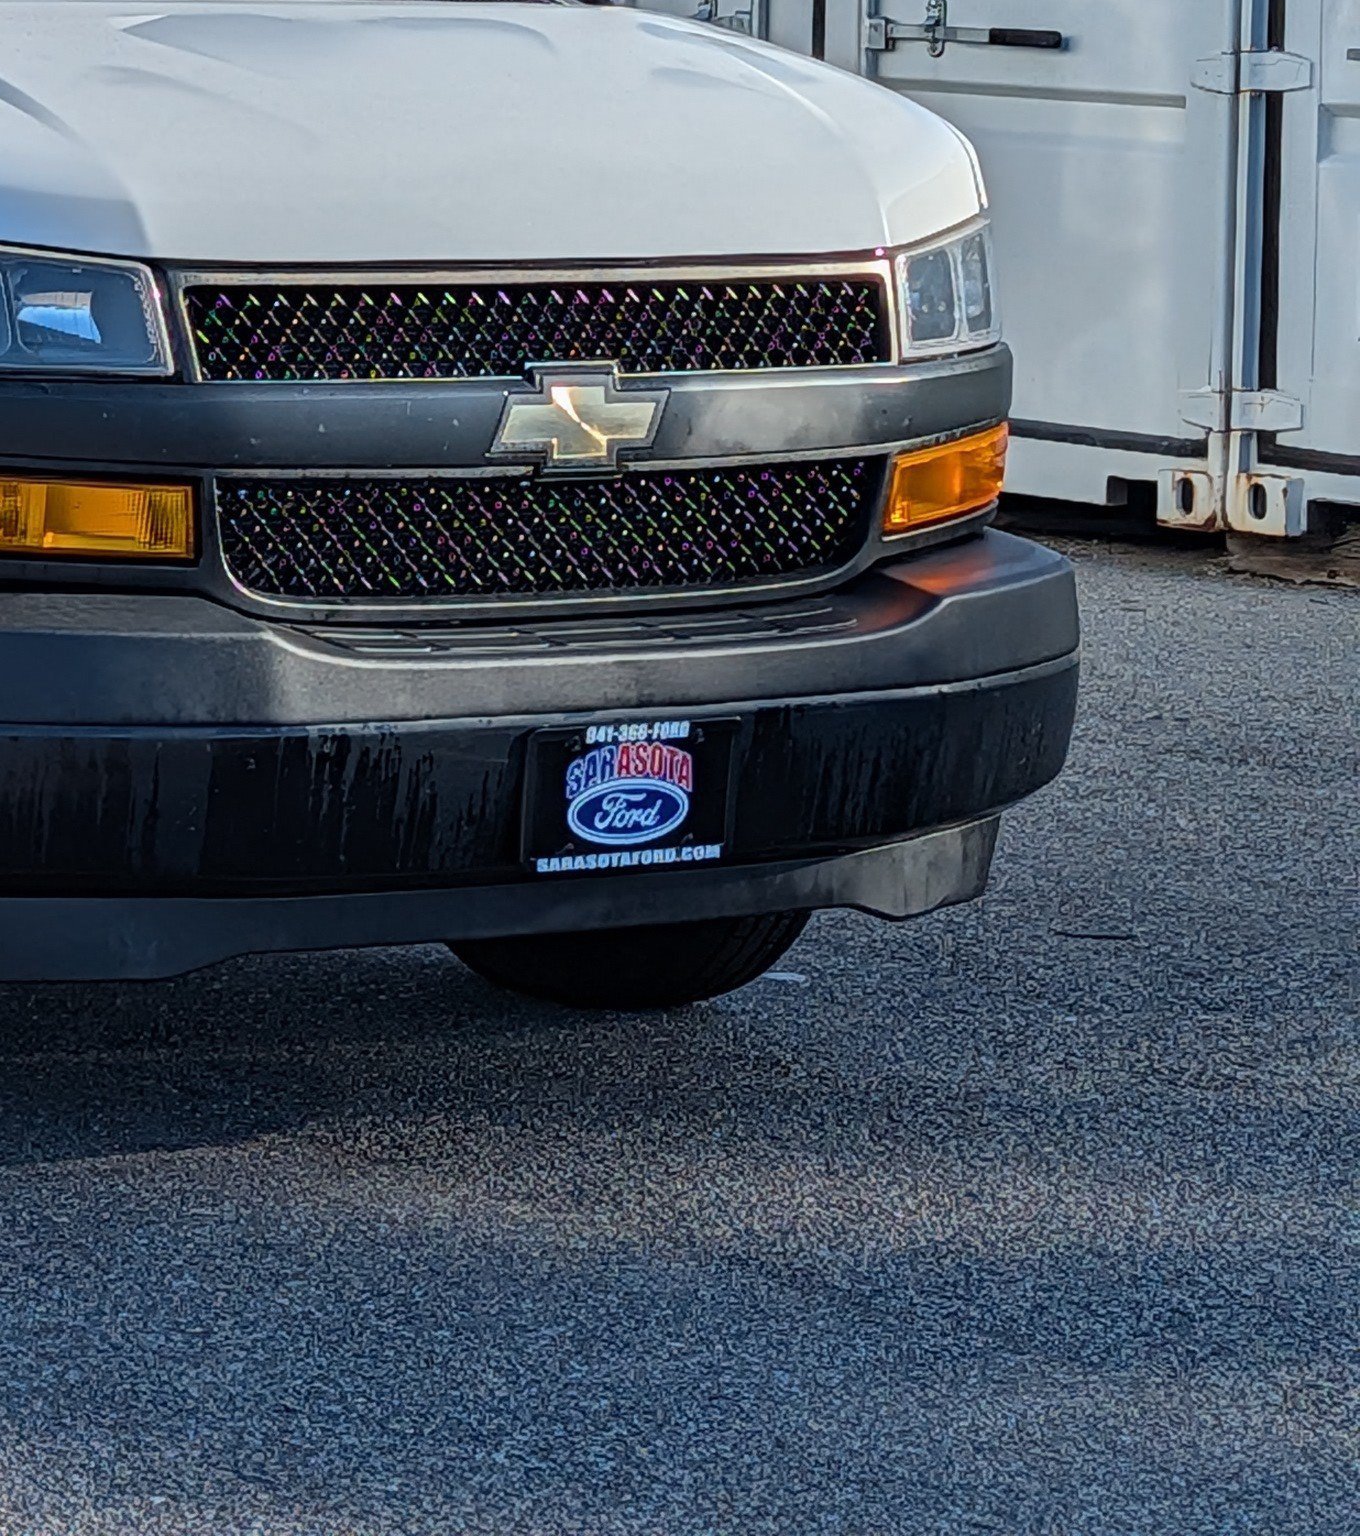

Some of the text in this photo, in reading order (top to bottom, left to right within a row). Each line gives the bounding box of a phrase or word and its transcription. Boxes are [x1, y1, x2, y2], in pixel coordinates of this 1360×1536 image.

[566, 742, 693, 799] SARASOTA
[593, 792, 662, 830] Ford
[536, 844, 721, 873] SARASOTAFORD.COM
